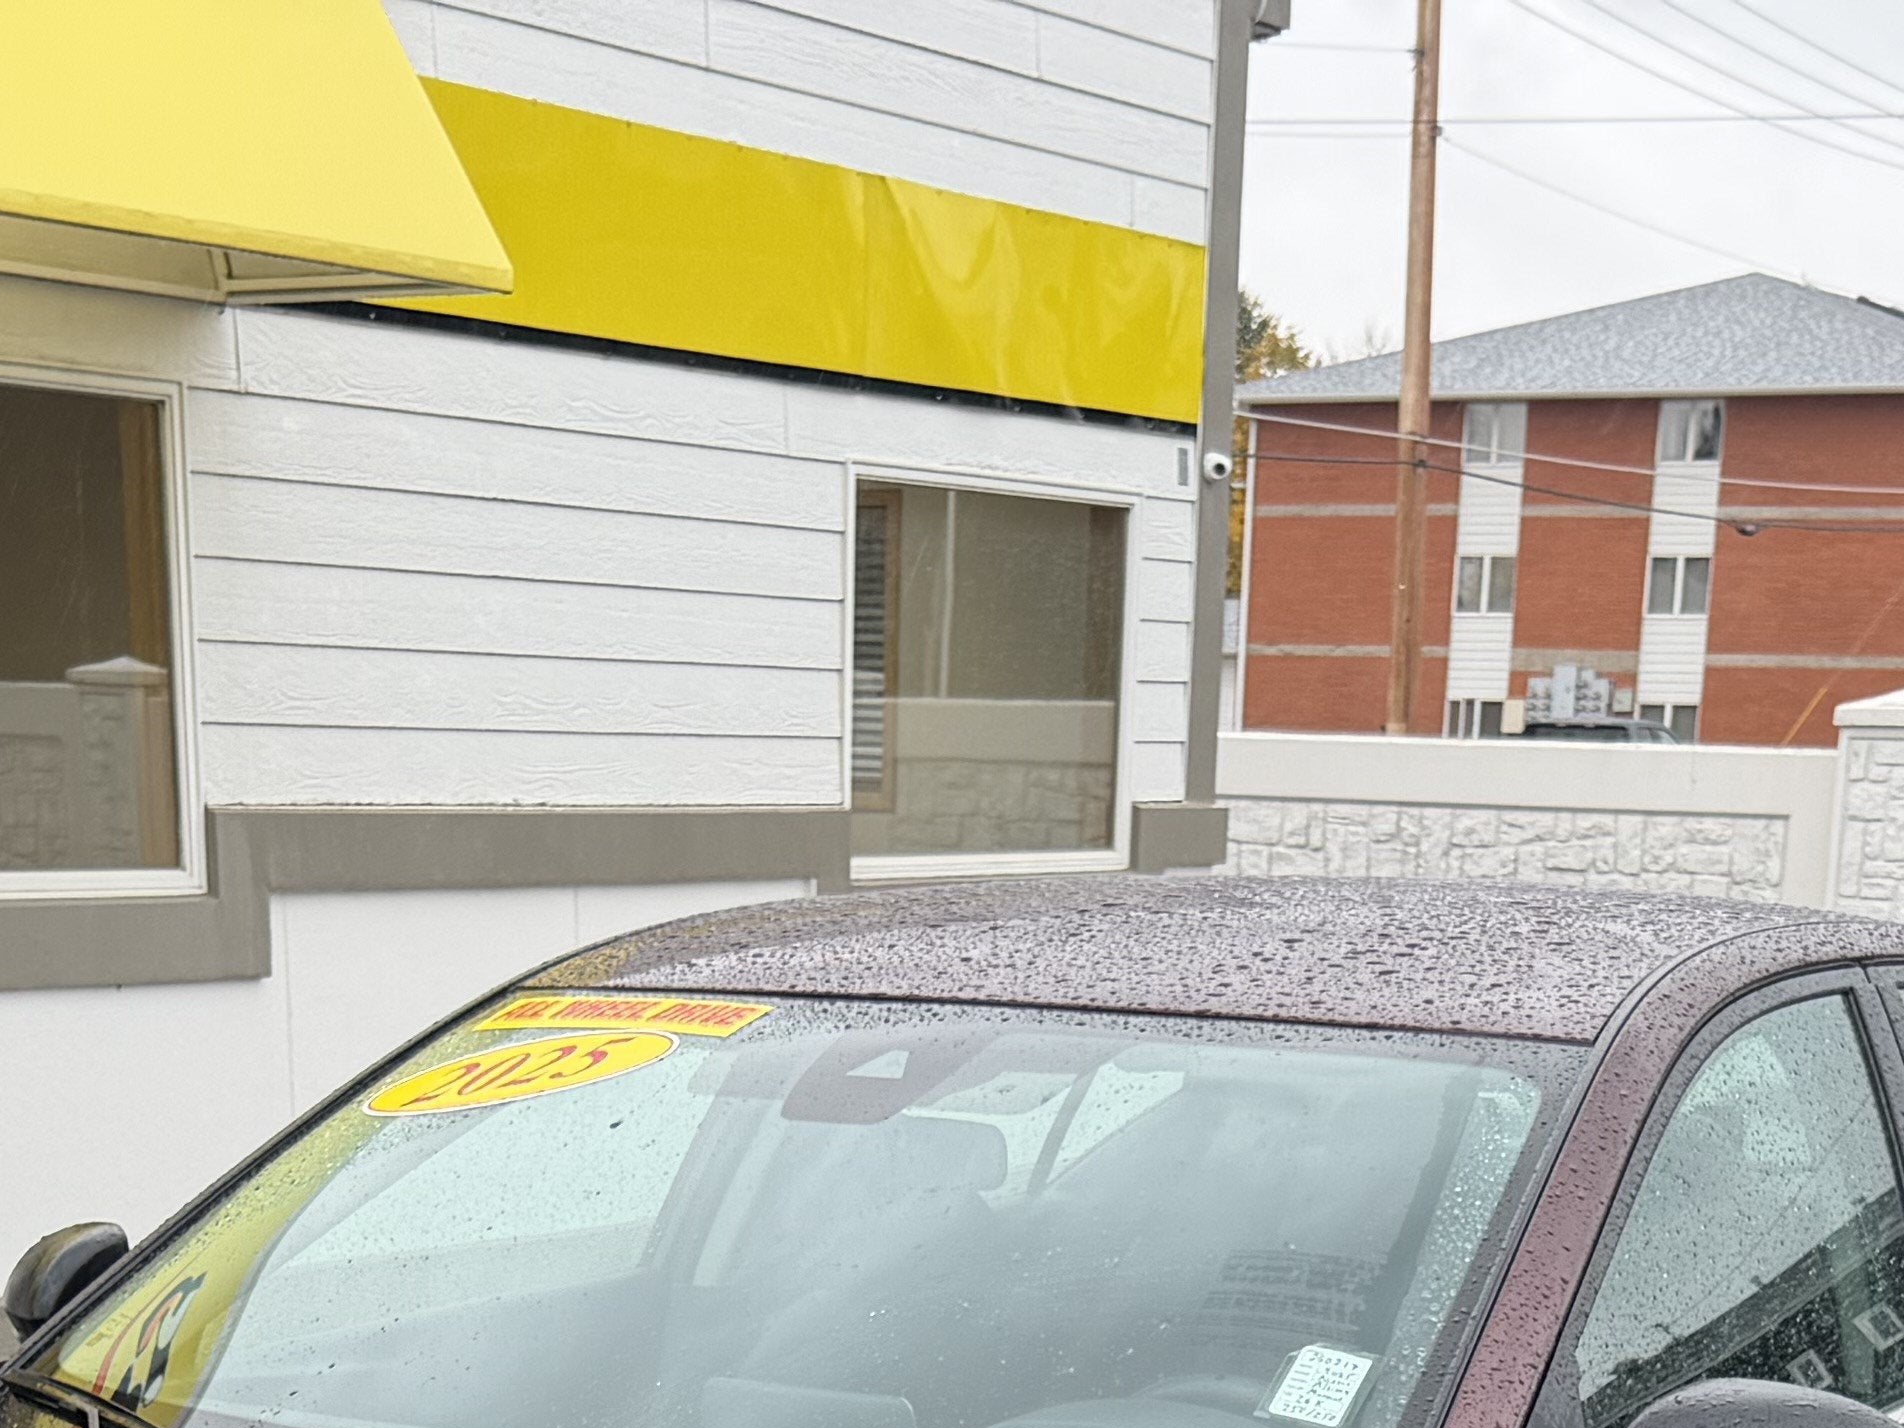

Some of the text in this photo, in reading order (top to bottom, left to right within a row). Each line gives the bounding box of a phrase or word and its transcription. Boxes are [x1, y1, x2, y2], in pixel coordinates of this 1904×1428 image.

[502, 1001, 758, 1027] ALL WHEEL DRIVE
[400, 1035, 641, 1108] 2025
